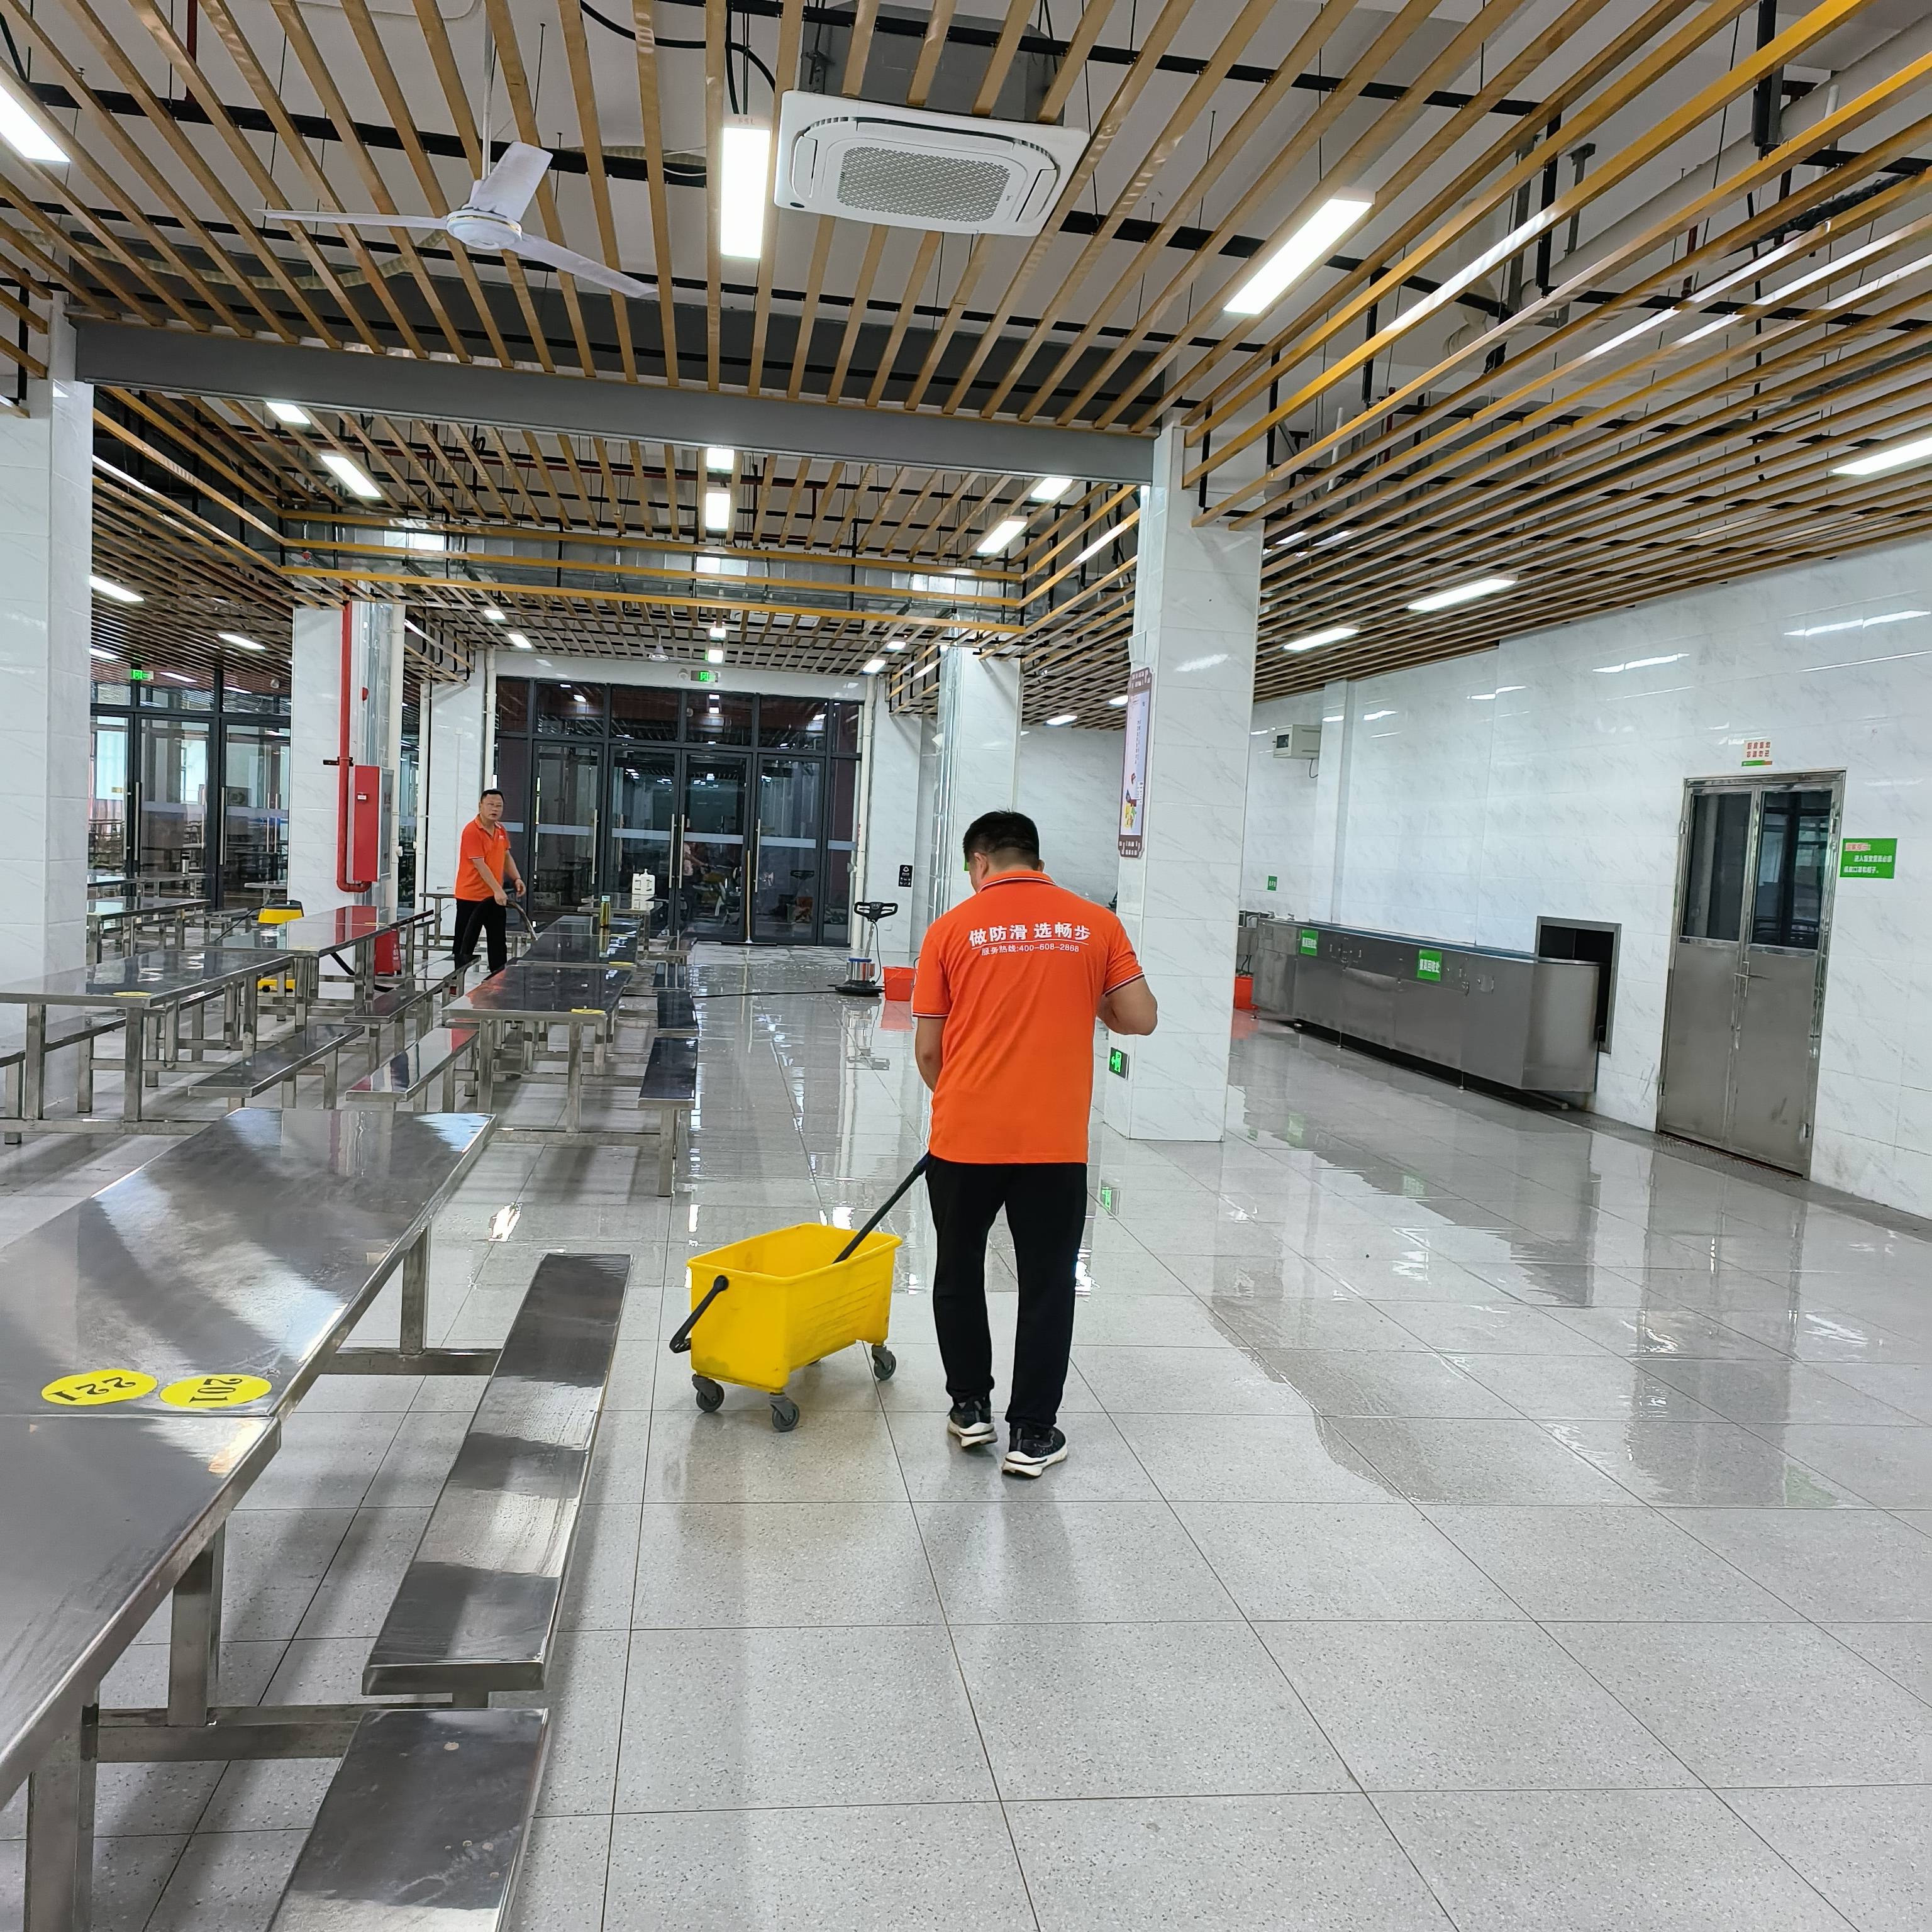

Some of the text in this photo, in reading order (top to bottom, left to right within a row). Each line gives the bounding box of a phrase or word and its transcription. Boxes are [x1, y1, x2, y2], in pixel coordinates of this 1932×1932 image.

[969, 922, 1091, 947] 做防滑 选畅步
